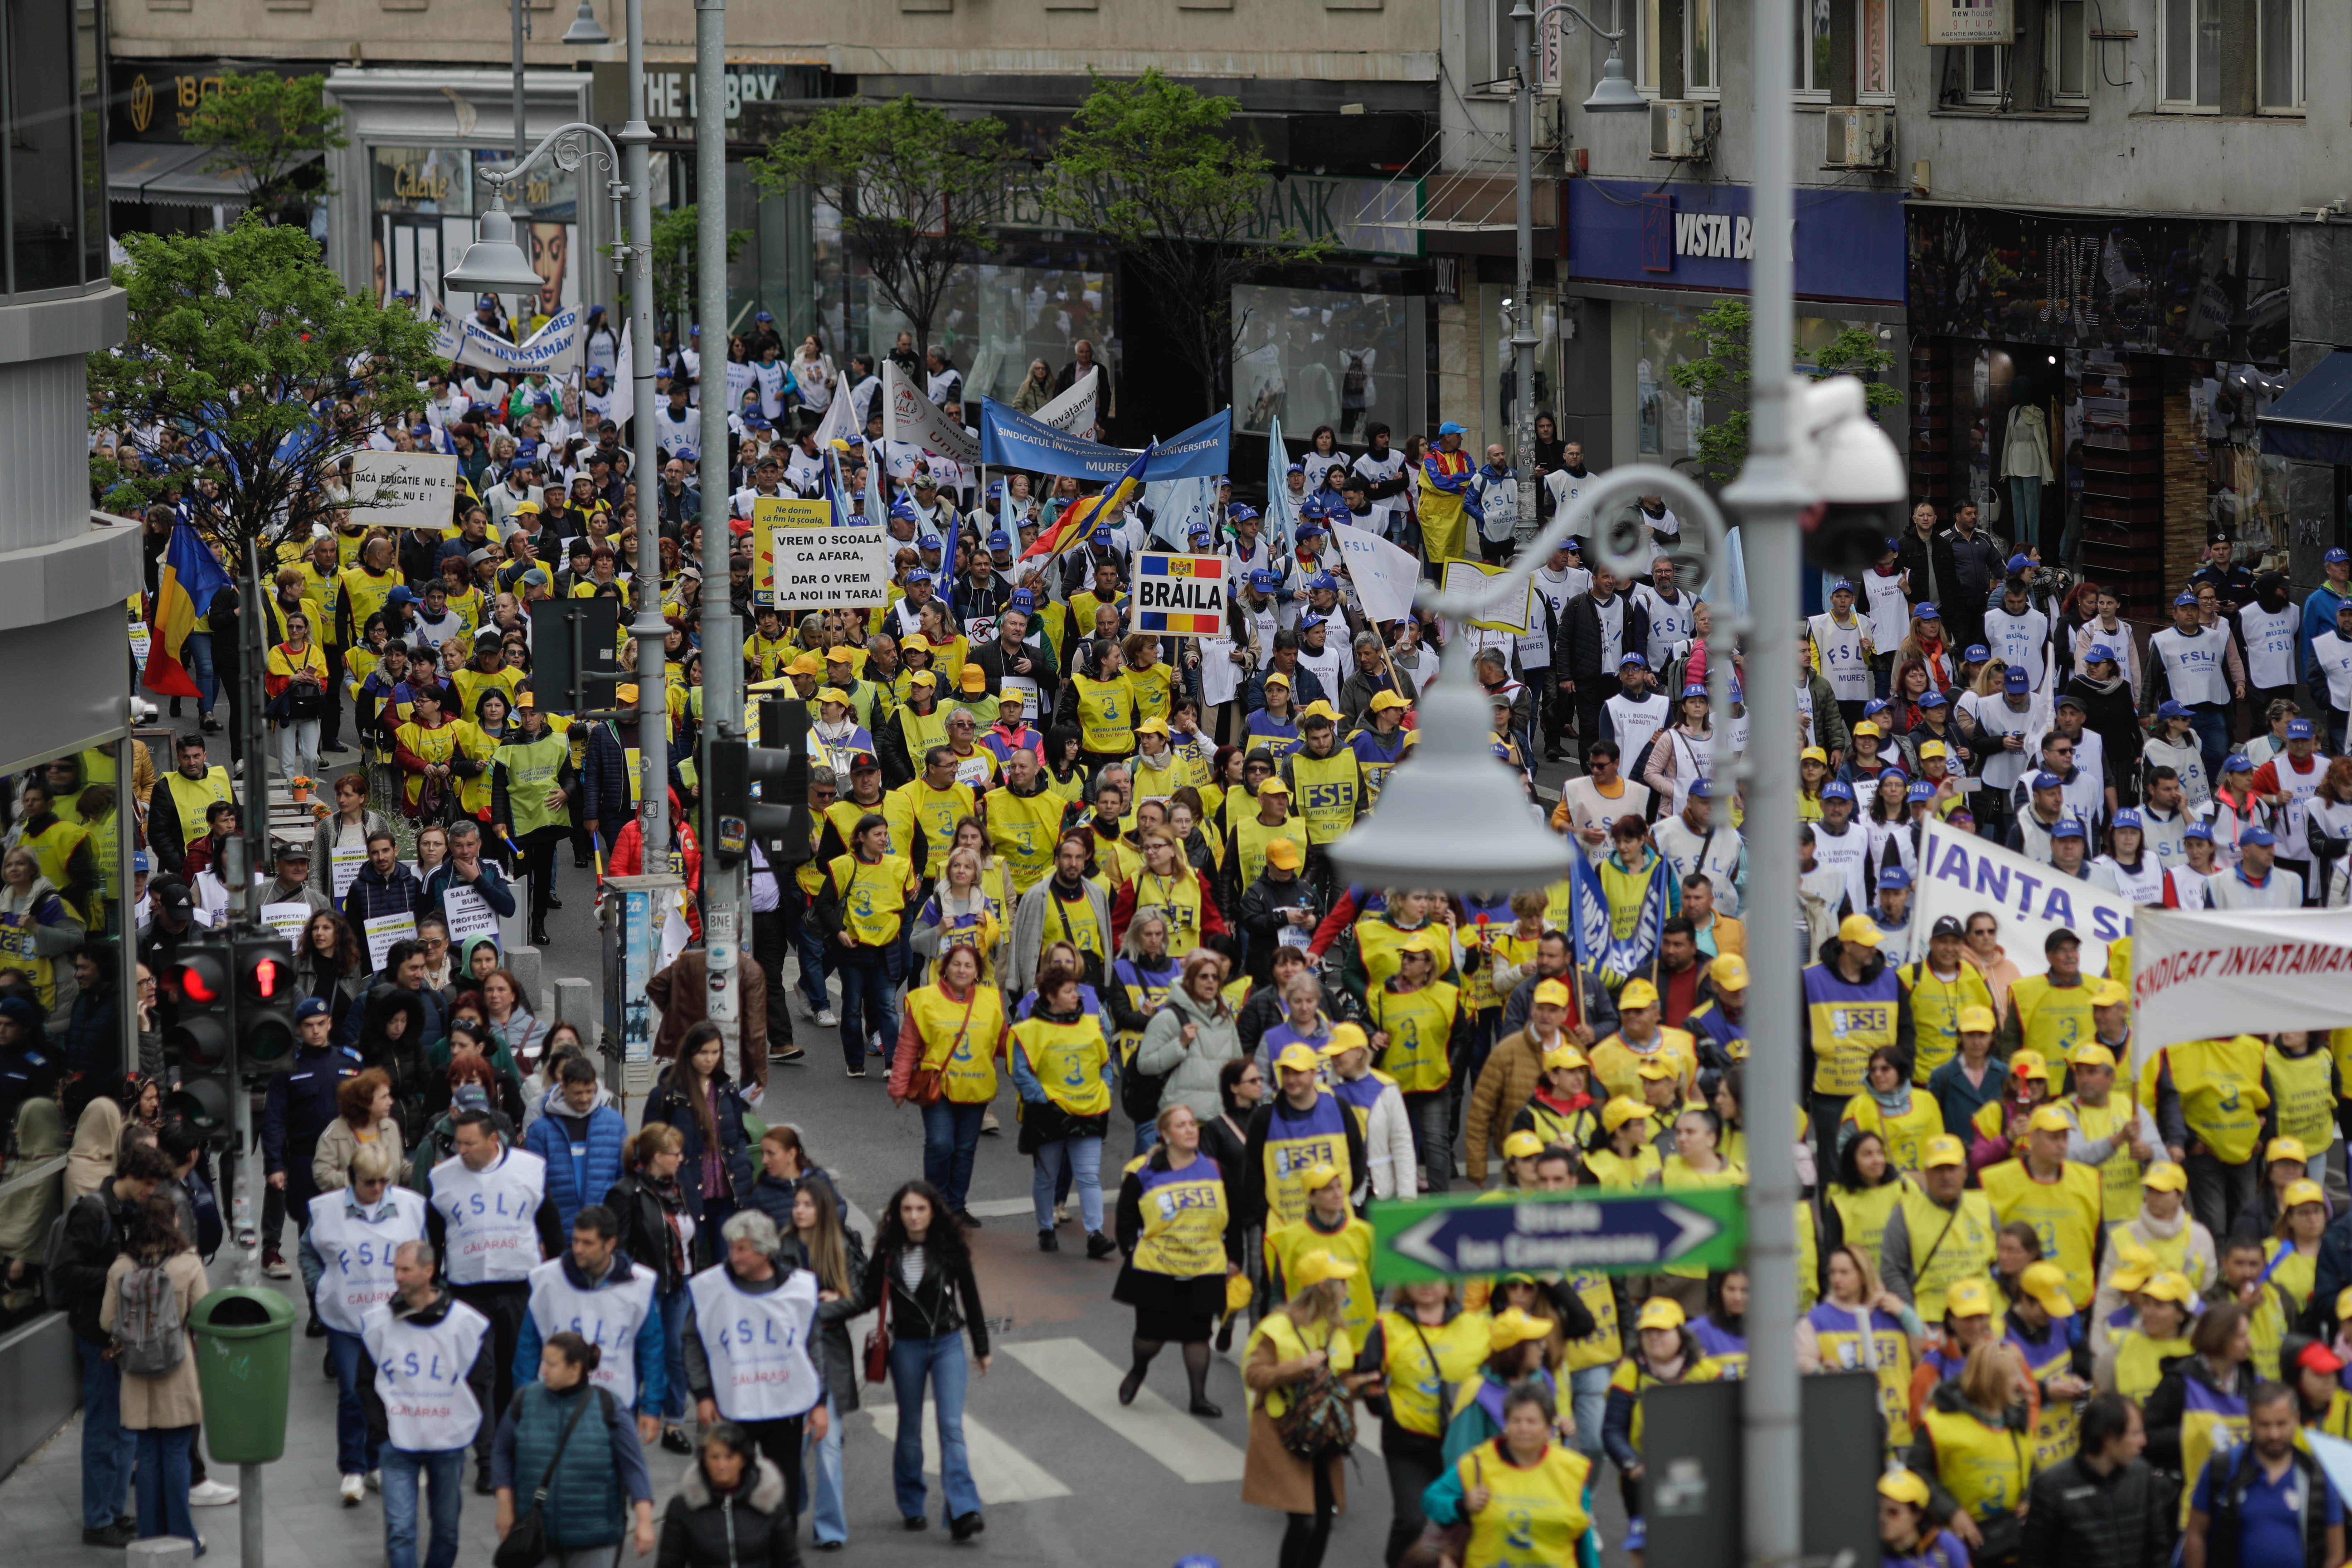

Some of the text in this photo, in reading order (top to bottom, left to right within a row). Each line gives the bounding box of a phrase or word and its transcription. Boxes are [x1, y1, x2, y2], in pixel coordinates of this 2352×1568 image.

[1676, 214, 1730, 258] VISTA
[997, 427, 1050, 448] SINDICATUL
[355, 472, 376, 482] DACĂ
[425, 478, 436, 486] NU
[778, 537, 813, 545] VREM
[818, 536, 827, 544] O
[1343, 541, 1375, 553] FSLI
[797, 552, 815, 561] CA
[792, 573, 870, 584] DAR O VREM
[781, 592, 796, 601] LA
[828, 591, 840, 599] IN
[1139, 577, 1223, 610] BRĂILA
[2180, 651, 2216, 664] FSLI
[957, 764, 984, 777] EDUCAȚIA
[1303, 783, 1352, 808] FSE
[1826, 785, 1846, 793] FSLI
[461, 895, 479, 906] BUN
[451, 911, 493, 926] PROFESOR
[709, 914, 730, 929] BNE
[454, 921, 490, 934] MOTIVAT
[1846, 1009, 1886, 1031] FSE
[1288, 1143, 1331, 1169] FSE
[1173, 1188, 1215, 1209] FSE
